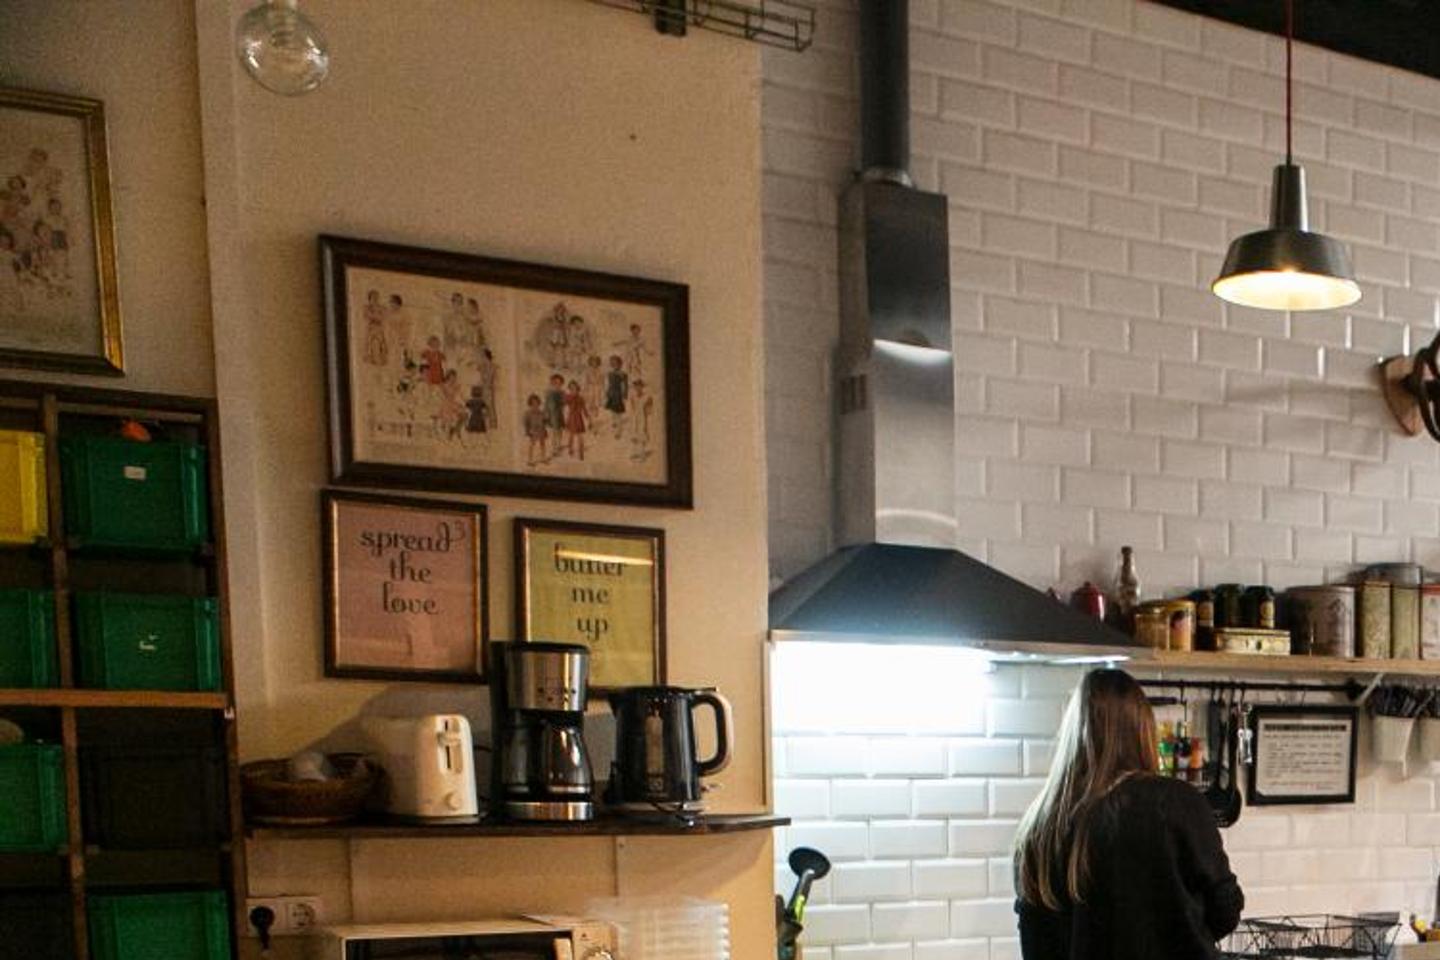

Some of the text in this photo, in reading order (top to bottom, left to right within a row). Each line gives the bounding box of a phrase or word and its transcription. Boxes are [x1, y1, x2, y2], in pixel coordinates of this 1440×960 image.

[358, 521, 465, 558] spread
[389, 550, 433, 584] the
[382, 581, 441, 616] love
[572, 587, 609, 605] me
[576, 617, 609, 642] up
